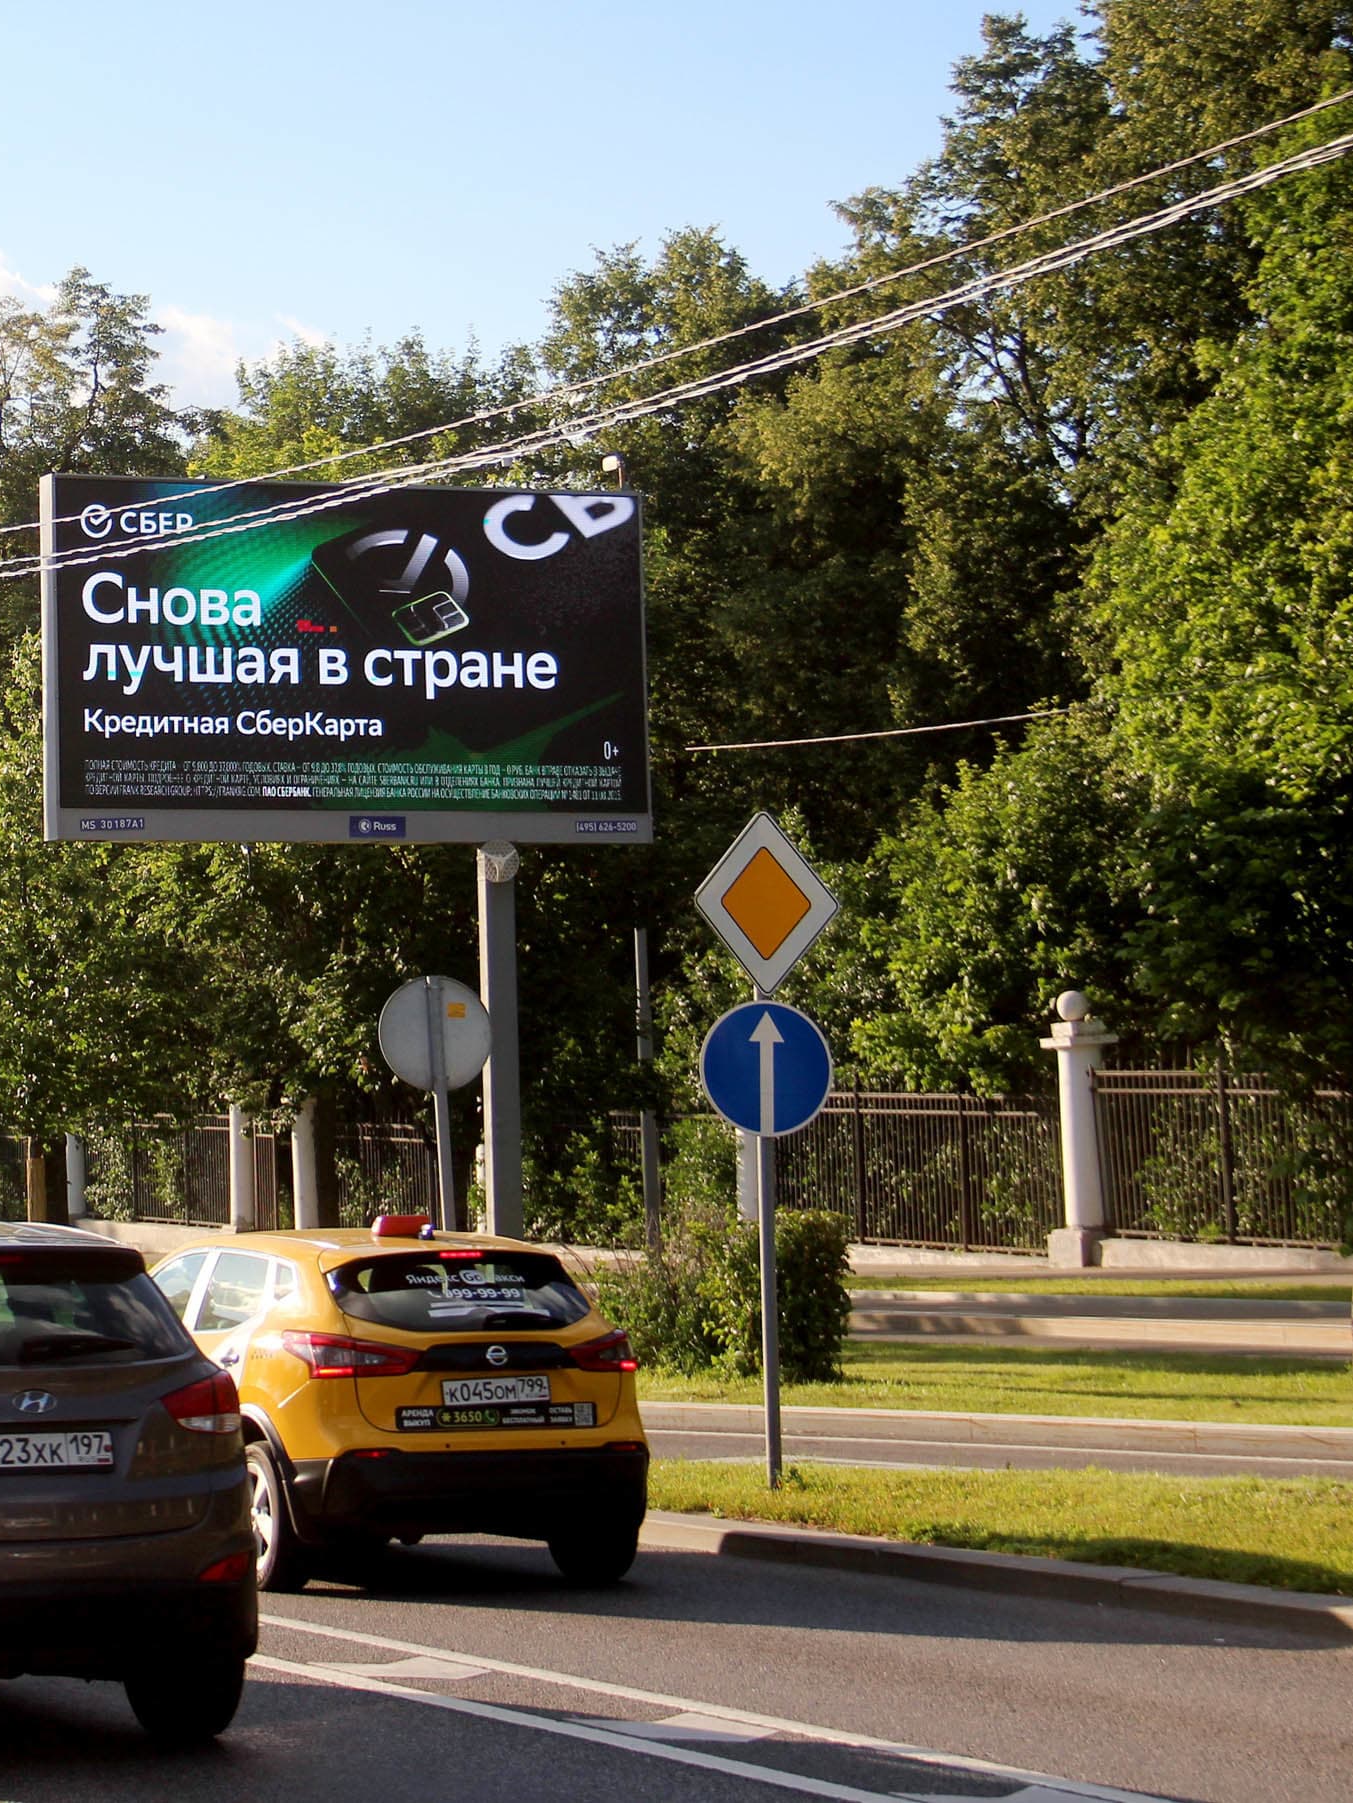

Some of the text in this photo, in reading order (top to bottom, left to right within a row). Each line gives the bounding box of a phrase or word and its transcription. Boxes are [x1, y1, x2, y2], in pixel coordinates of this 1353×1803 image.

[120, 511, 193, 534] СБЕР
[82, 571, 262, 627] Снова
[82, 643, 558, 700] лучшая в стране
[83, 708, 383, 741] Кредитная СберКарта
[604, 741, 620, 760] 0+
[81, 820, 96, 830] MS
[373, 821, 397, 831] Russ
[406, 1273, 461, 1285] Яндекс
[491, 1273, 526, 1284] акси
[449, 1378, 544, 1403] К045ОМ 799
[401, 1409, 434, 1418] АРЕНДА
[69, 1434, 104, 1456] 197
